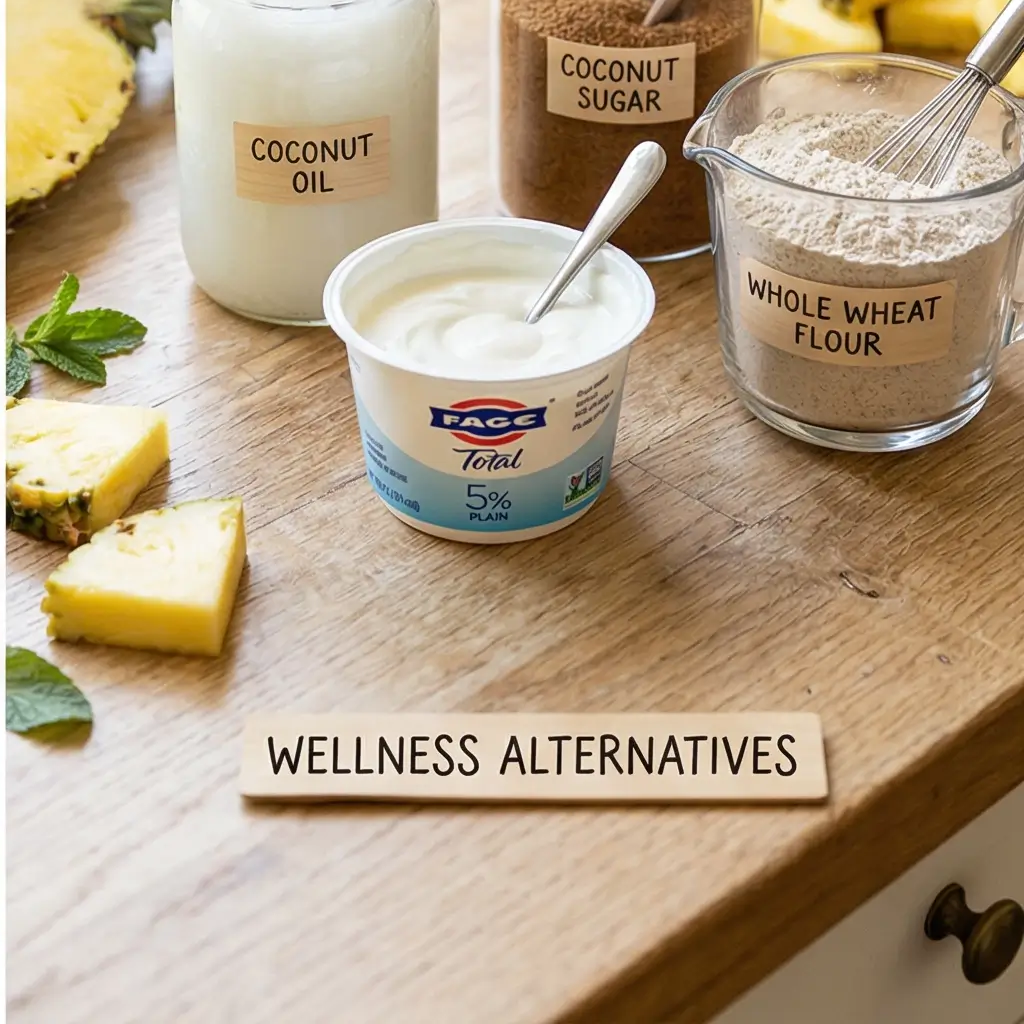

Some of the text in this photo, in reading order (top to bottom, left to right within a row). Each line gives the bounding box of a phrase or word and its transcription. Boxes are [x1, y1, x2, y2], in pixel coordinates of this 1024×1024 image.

[561, 53, 679, 82] COCONUT
[577, 86, 662, 113] SUGAR
[251, 133, 373, 164] COCONUT
[292, 170, 333, 194] OIL
[748, 272, 942, 325] WHOLE WHEAT
[795, 322, 883, 356] FLOUR
[452, 448, 524, 472] Total
[465, 484, 512, 510] 5%
[469, 512, 508, 521] PLAIN
[267, 734, 798, 776] WELLNESS ALTERNATIVES
